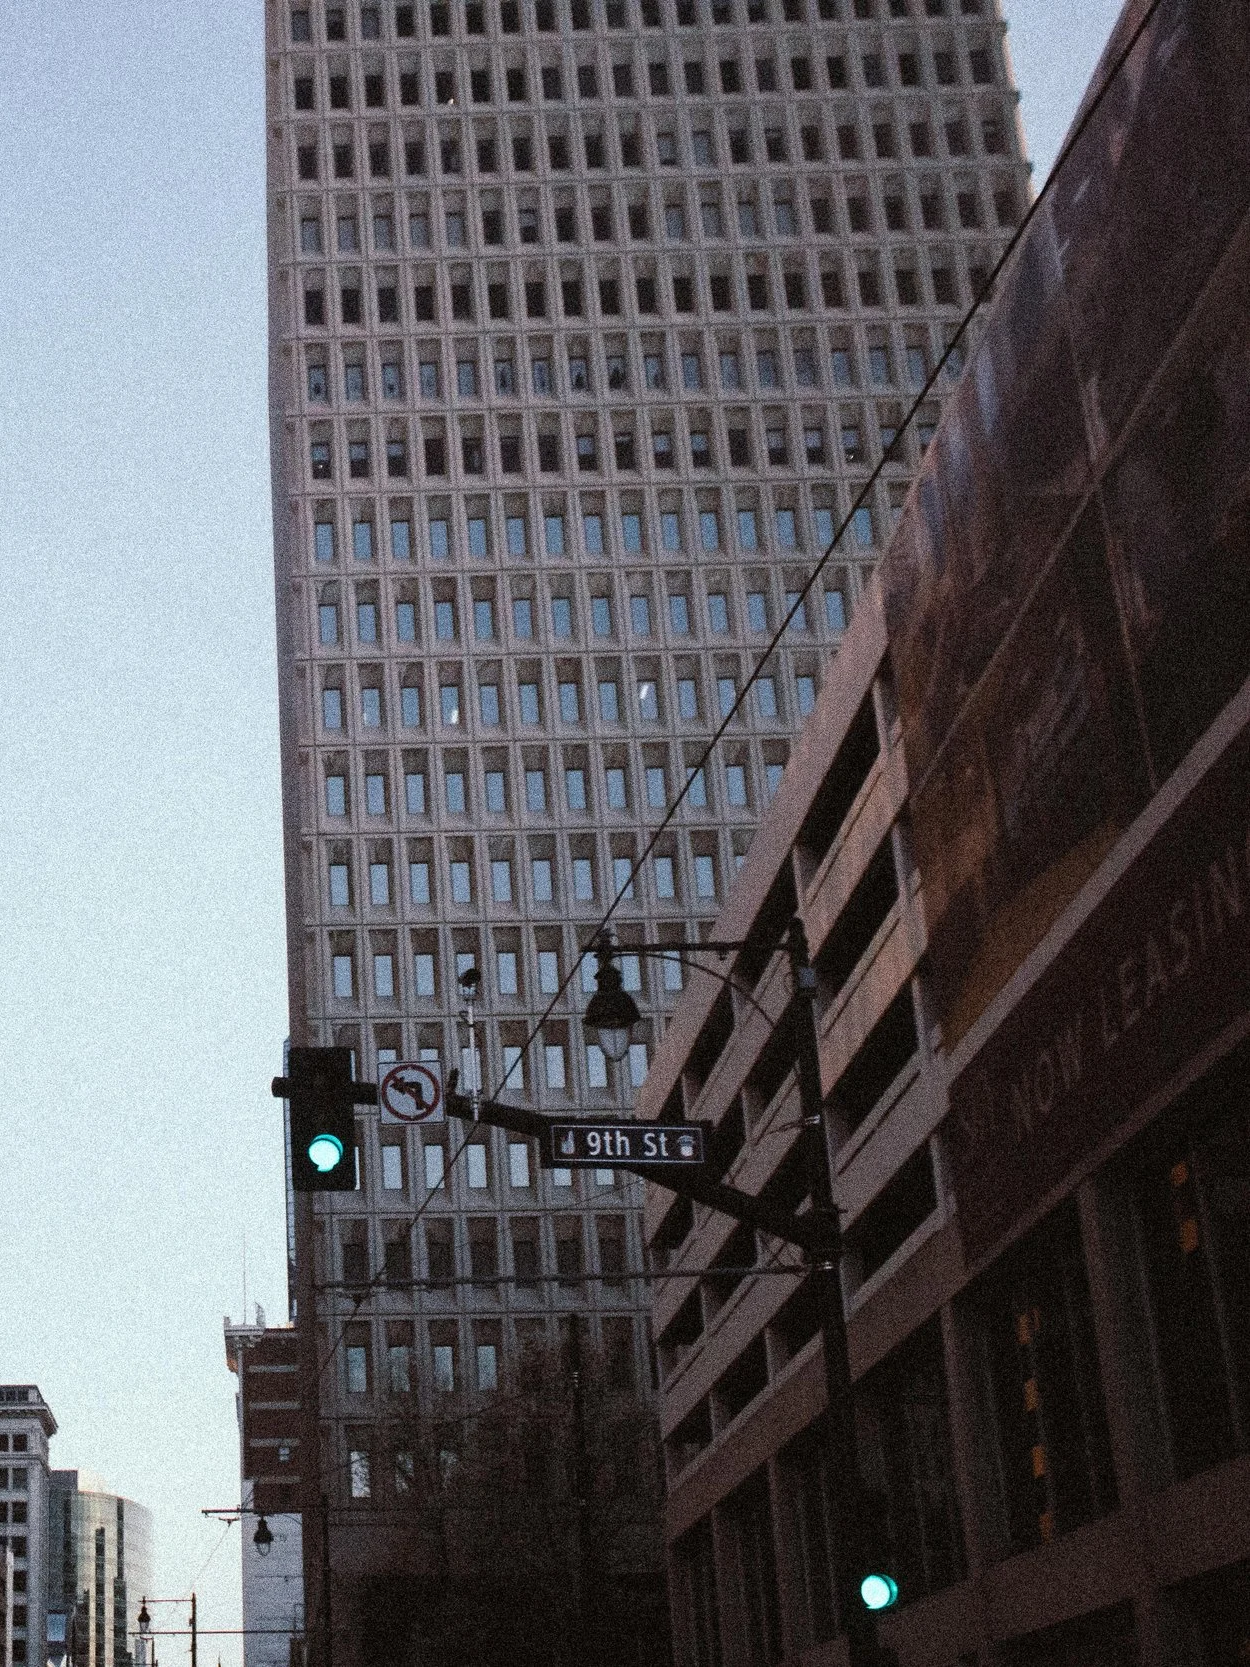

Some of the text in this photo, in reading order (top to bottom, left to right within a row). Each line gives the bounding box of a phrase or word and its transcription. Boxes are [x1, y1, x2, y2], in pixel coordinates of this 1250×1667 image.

[1011, 822, 1250, 1143] NOW LEASIN
[586, 1130, 669, 1157] 9th St
